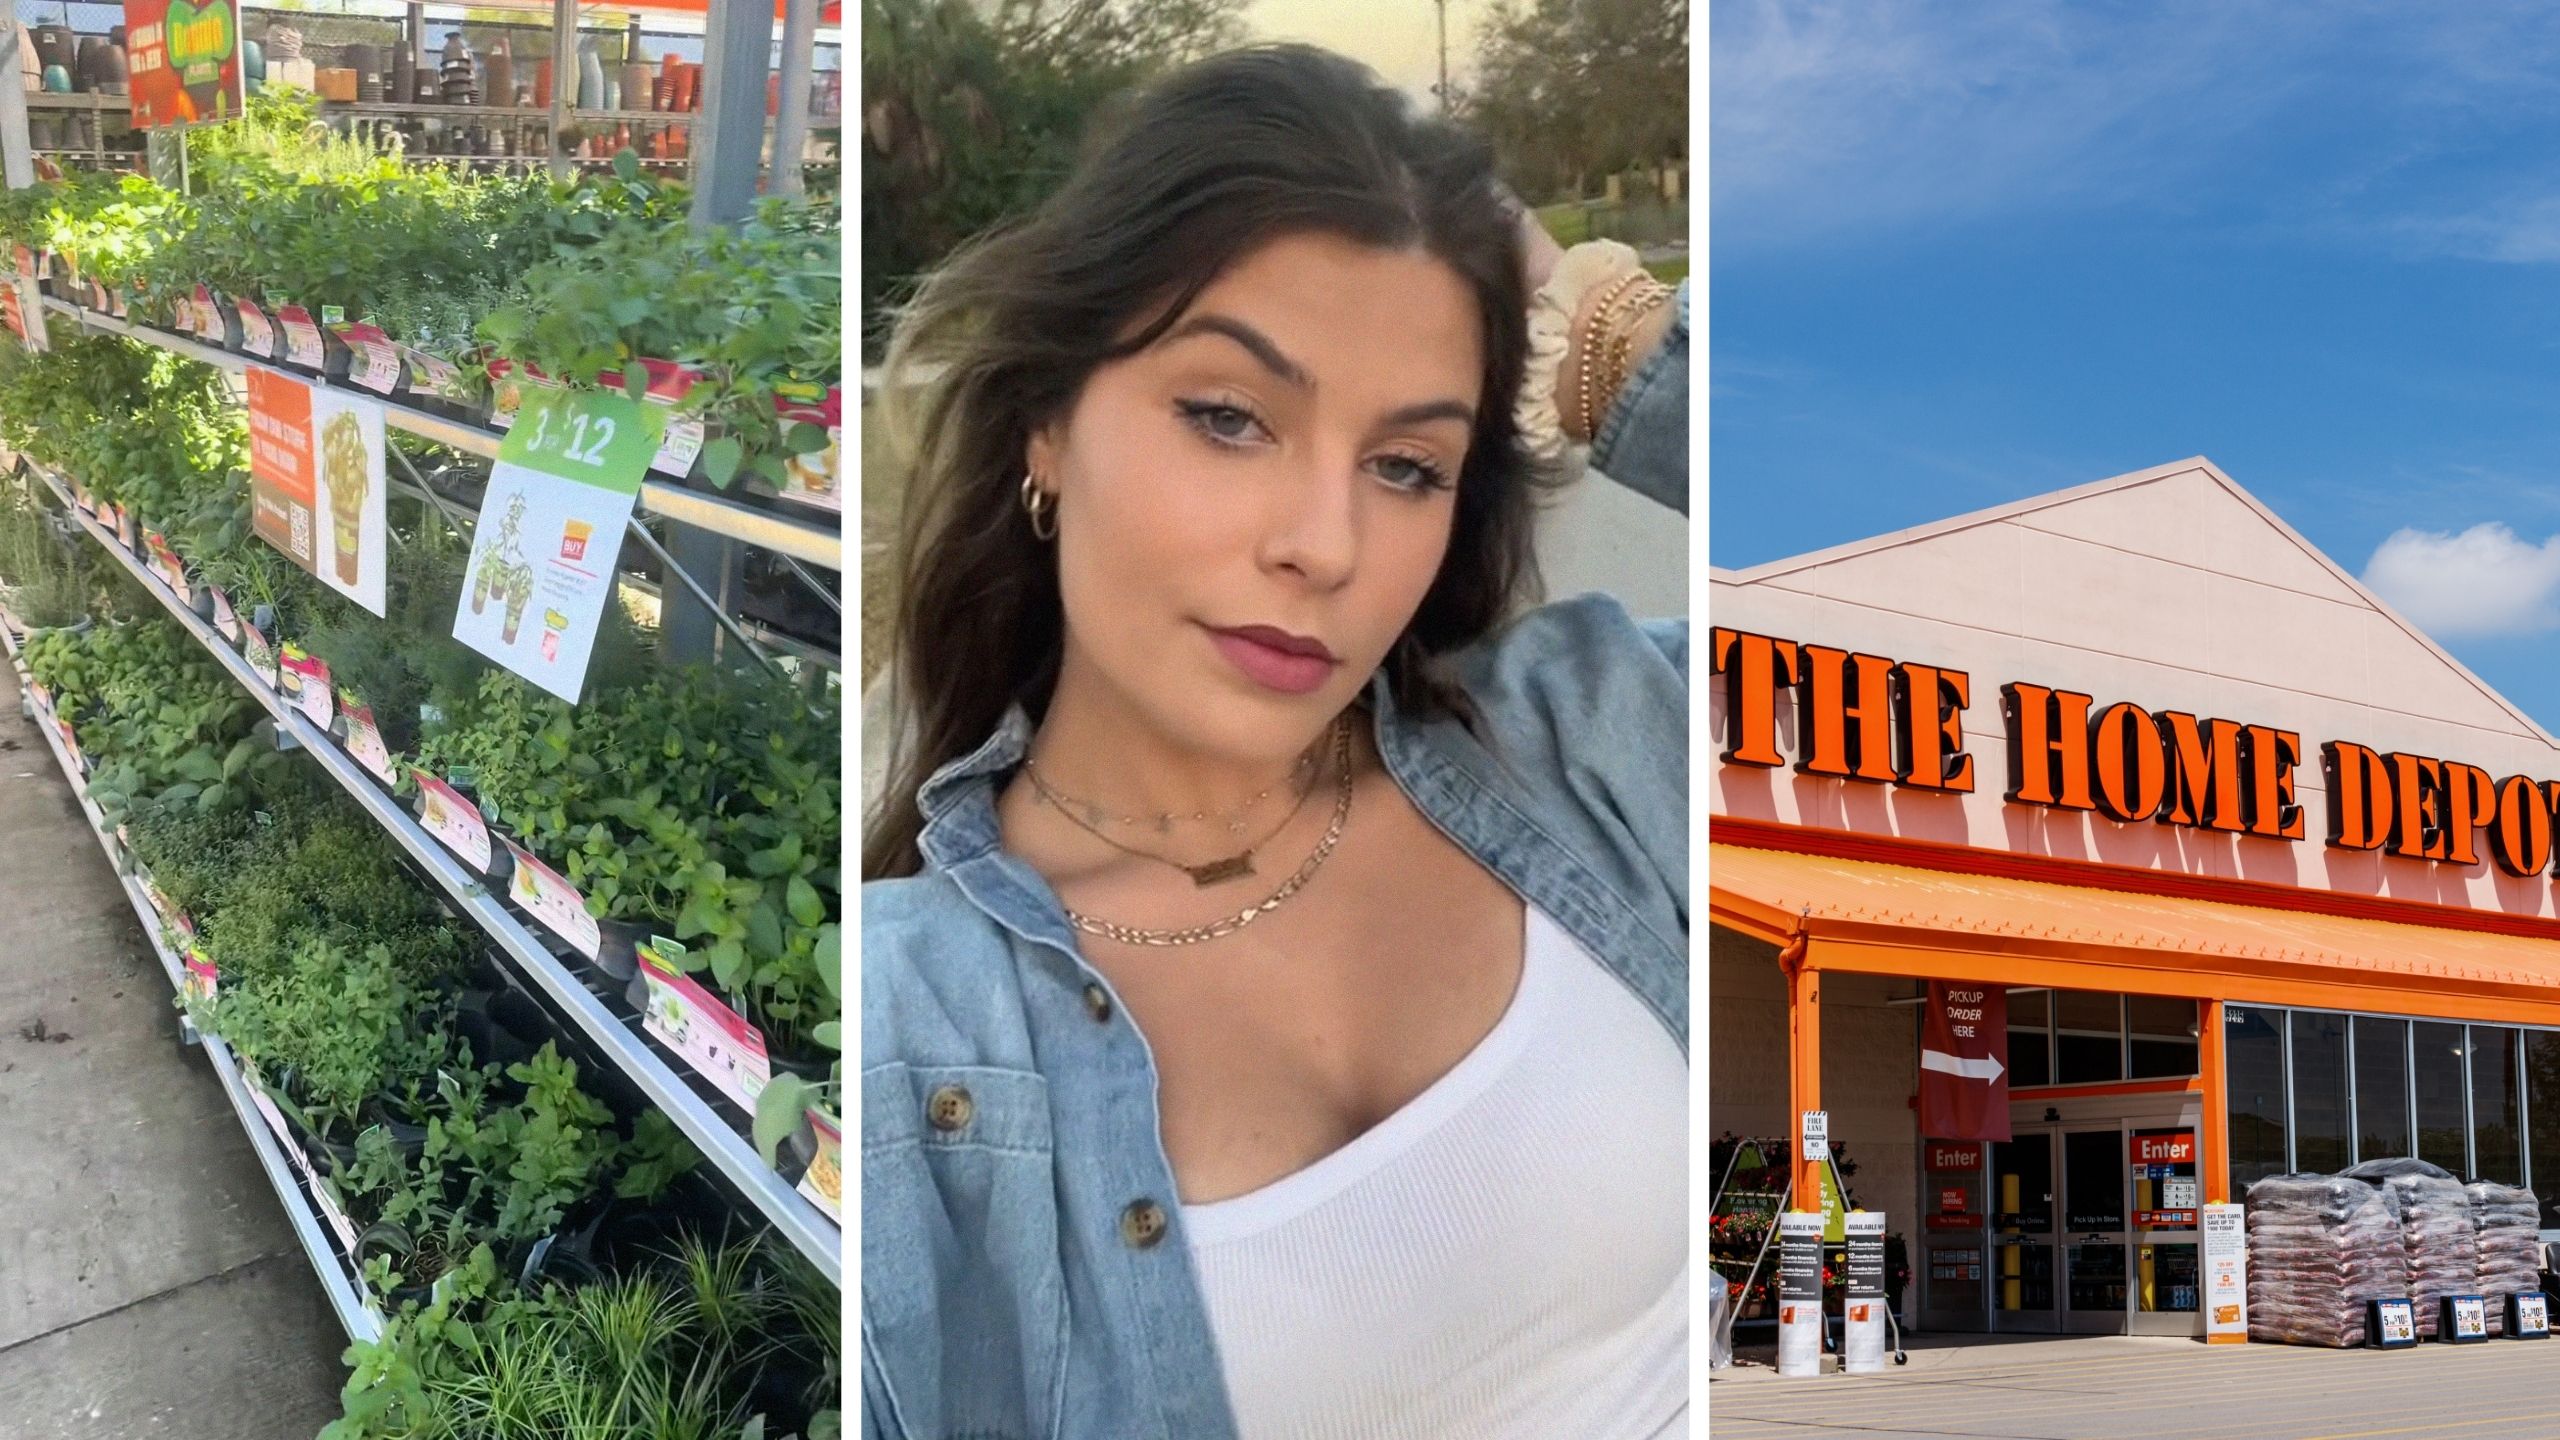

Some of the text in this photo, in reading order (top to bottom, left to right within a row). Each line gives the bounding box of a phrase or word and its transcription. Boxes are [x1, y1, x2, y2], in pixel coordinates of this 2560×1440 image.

[526, 407, 548, 451] 3
[563, 539, 584, 554] BUY
[1710, 626, 1974, 793] THE
[2000, 681, 2305, 841] HOME
[1948, 990, 1984, 1003] PICKUP
[1946, 1006, 1982, 1020] ORDER
[1952, 1025, 1975, 1037] HERE
[2141, 1140, 2189, 1159] Enter
[1936, 1149, 1977, 1167] Enter
[1942, 1191, 1957, 1199] NOW
[2087, 1216, 2095, 1224] Up
[1848, 1223, 1877, 1231] AVAILABLE
[1848, 1252, 1855, 1260] 12
[2457, 1310, 2463, 1321] 5
[2521, 1308, 2526, 1318] 5
[2384, 1315, 2389, 1326] 5
